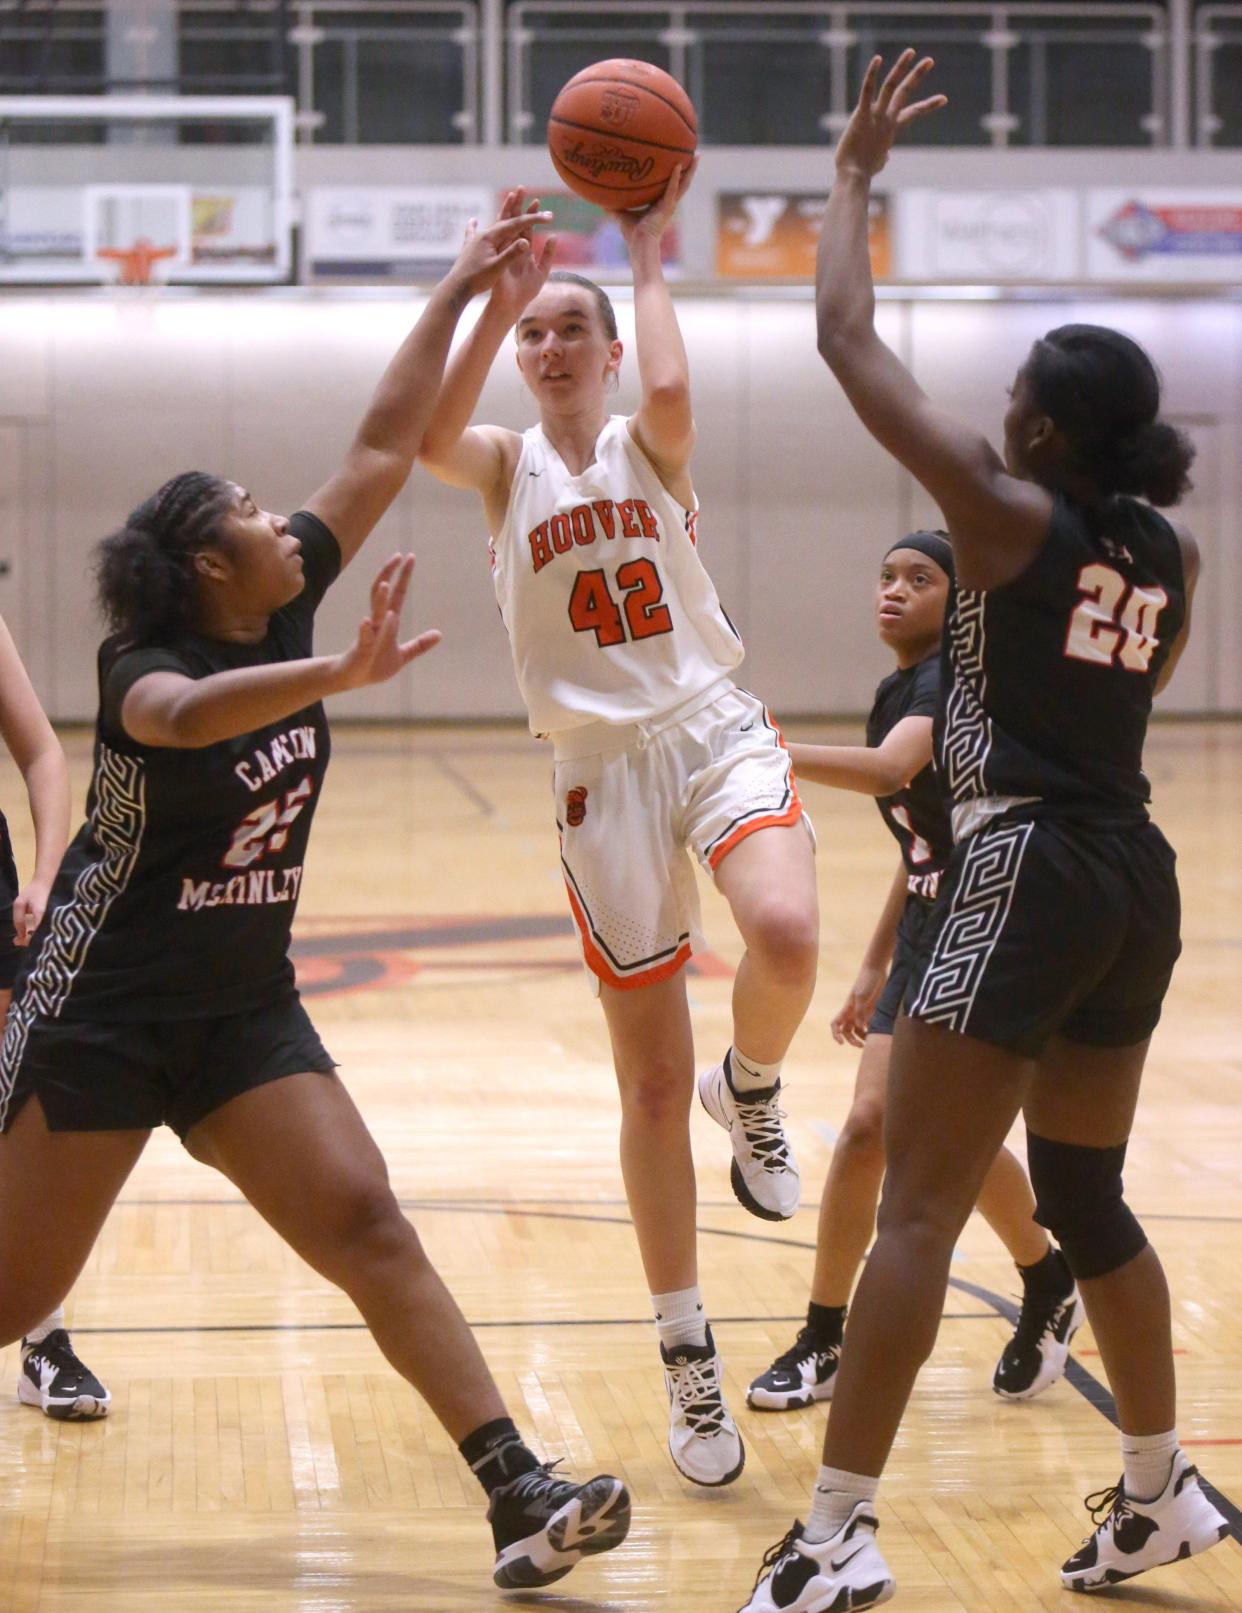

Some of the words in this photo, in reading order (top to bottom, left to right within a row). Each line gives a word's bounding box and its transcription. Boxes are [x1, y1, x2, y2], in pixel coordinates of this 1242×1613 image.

[564, 142, 655, 182] Rawlings
[528, 498, 660, 574] HOOVER
[568, 556, 674, 649] 42
[1062, 562, 1169, 674] 20
